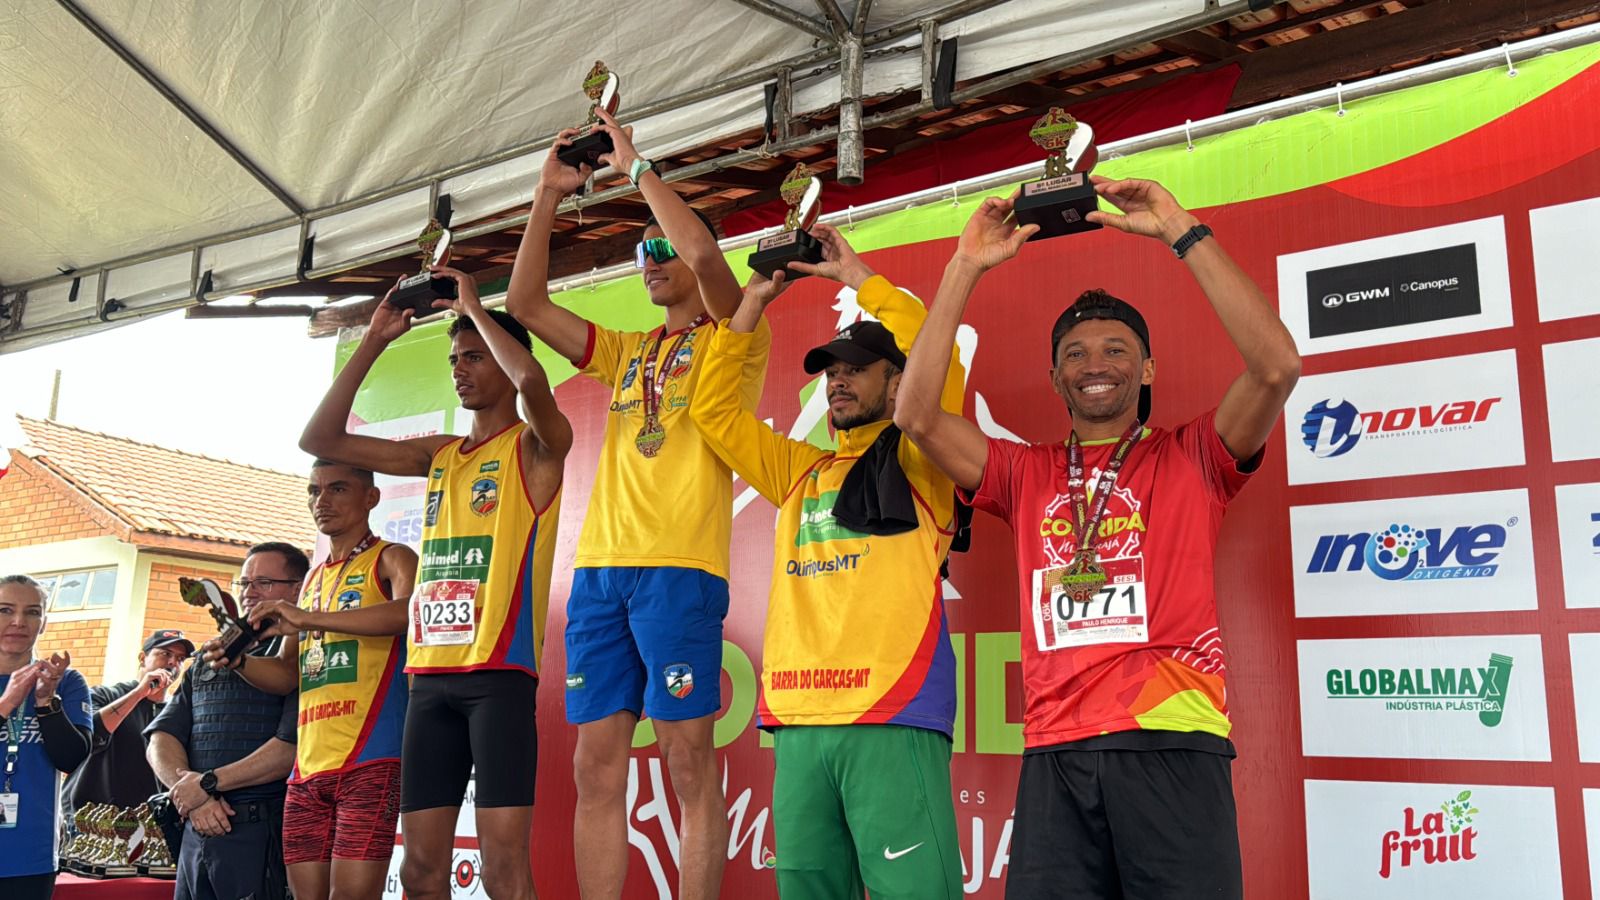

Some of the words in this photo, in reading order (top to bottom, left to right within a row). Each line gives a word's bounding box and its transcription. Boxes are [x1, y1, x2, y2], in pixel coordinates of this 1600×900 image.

[1346, 287, 1390, 303] GWM
[1410, 277, 1459, 291] Canopus
[384, 516, 423, 543] SES
[1040, 511, 1146, 537] CORIDA
[423, 602, 471, 626] 0233
[1100, 617, 1129, 626] HENRIQUE
[771, 671, 799, 690] BARRA
[800, 669, 812, 689] DO
[813, 668, 871, 693] GARÇAS-MT
[1326, 667, 1501, 696] GLOBALMAX
[1386, 699, 1443, 711] INDÚSTRIA
[1446, 699, 1501, 711] PLÁSTICA
[1404, 807, 1444, 837] La
[1378, 826, 1478, 878] fruit
